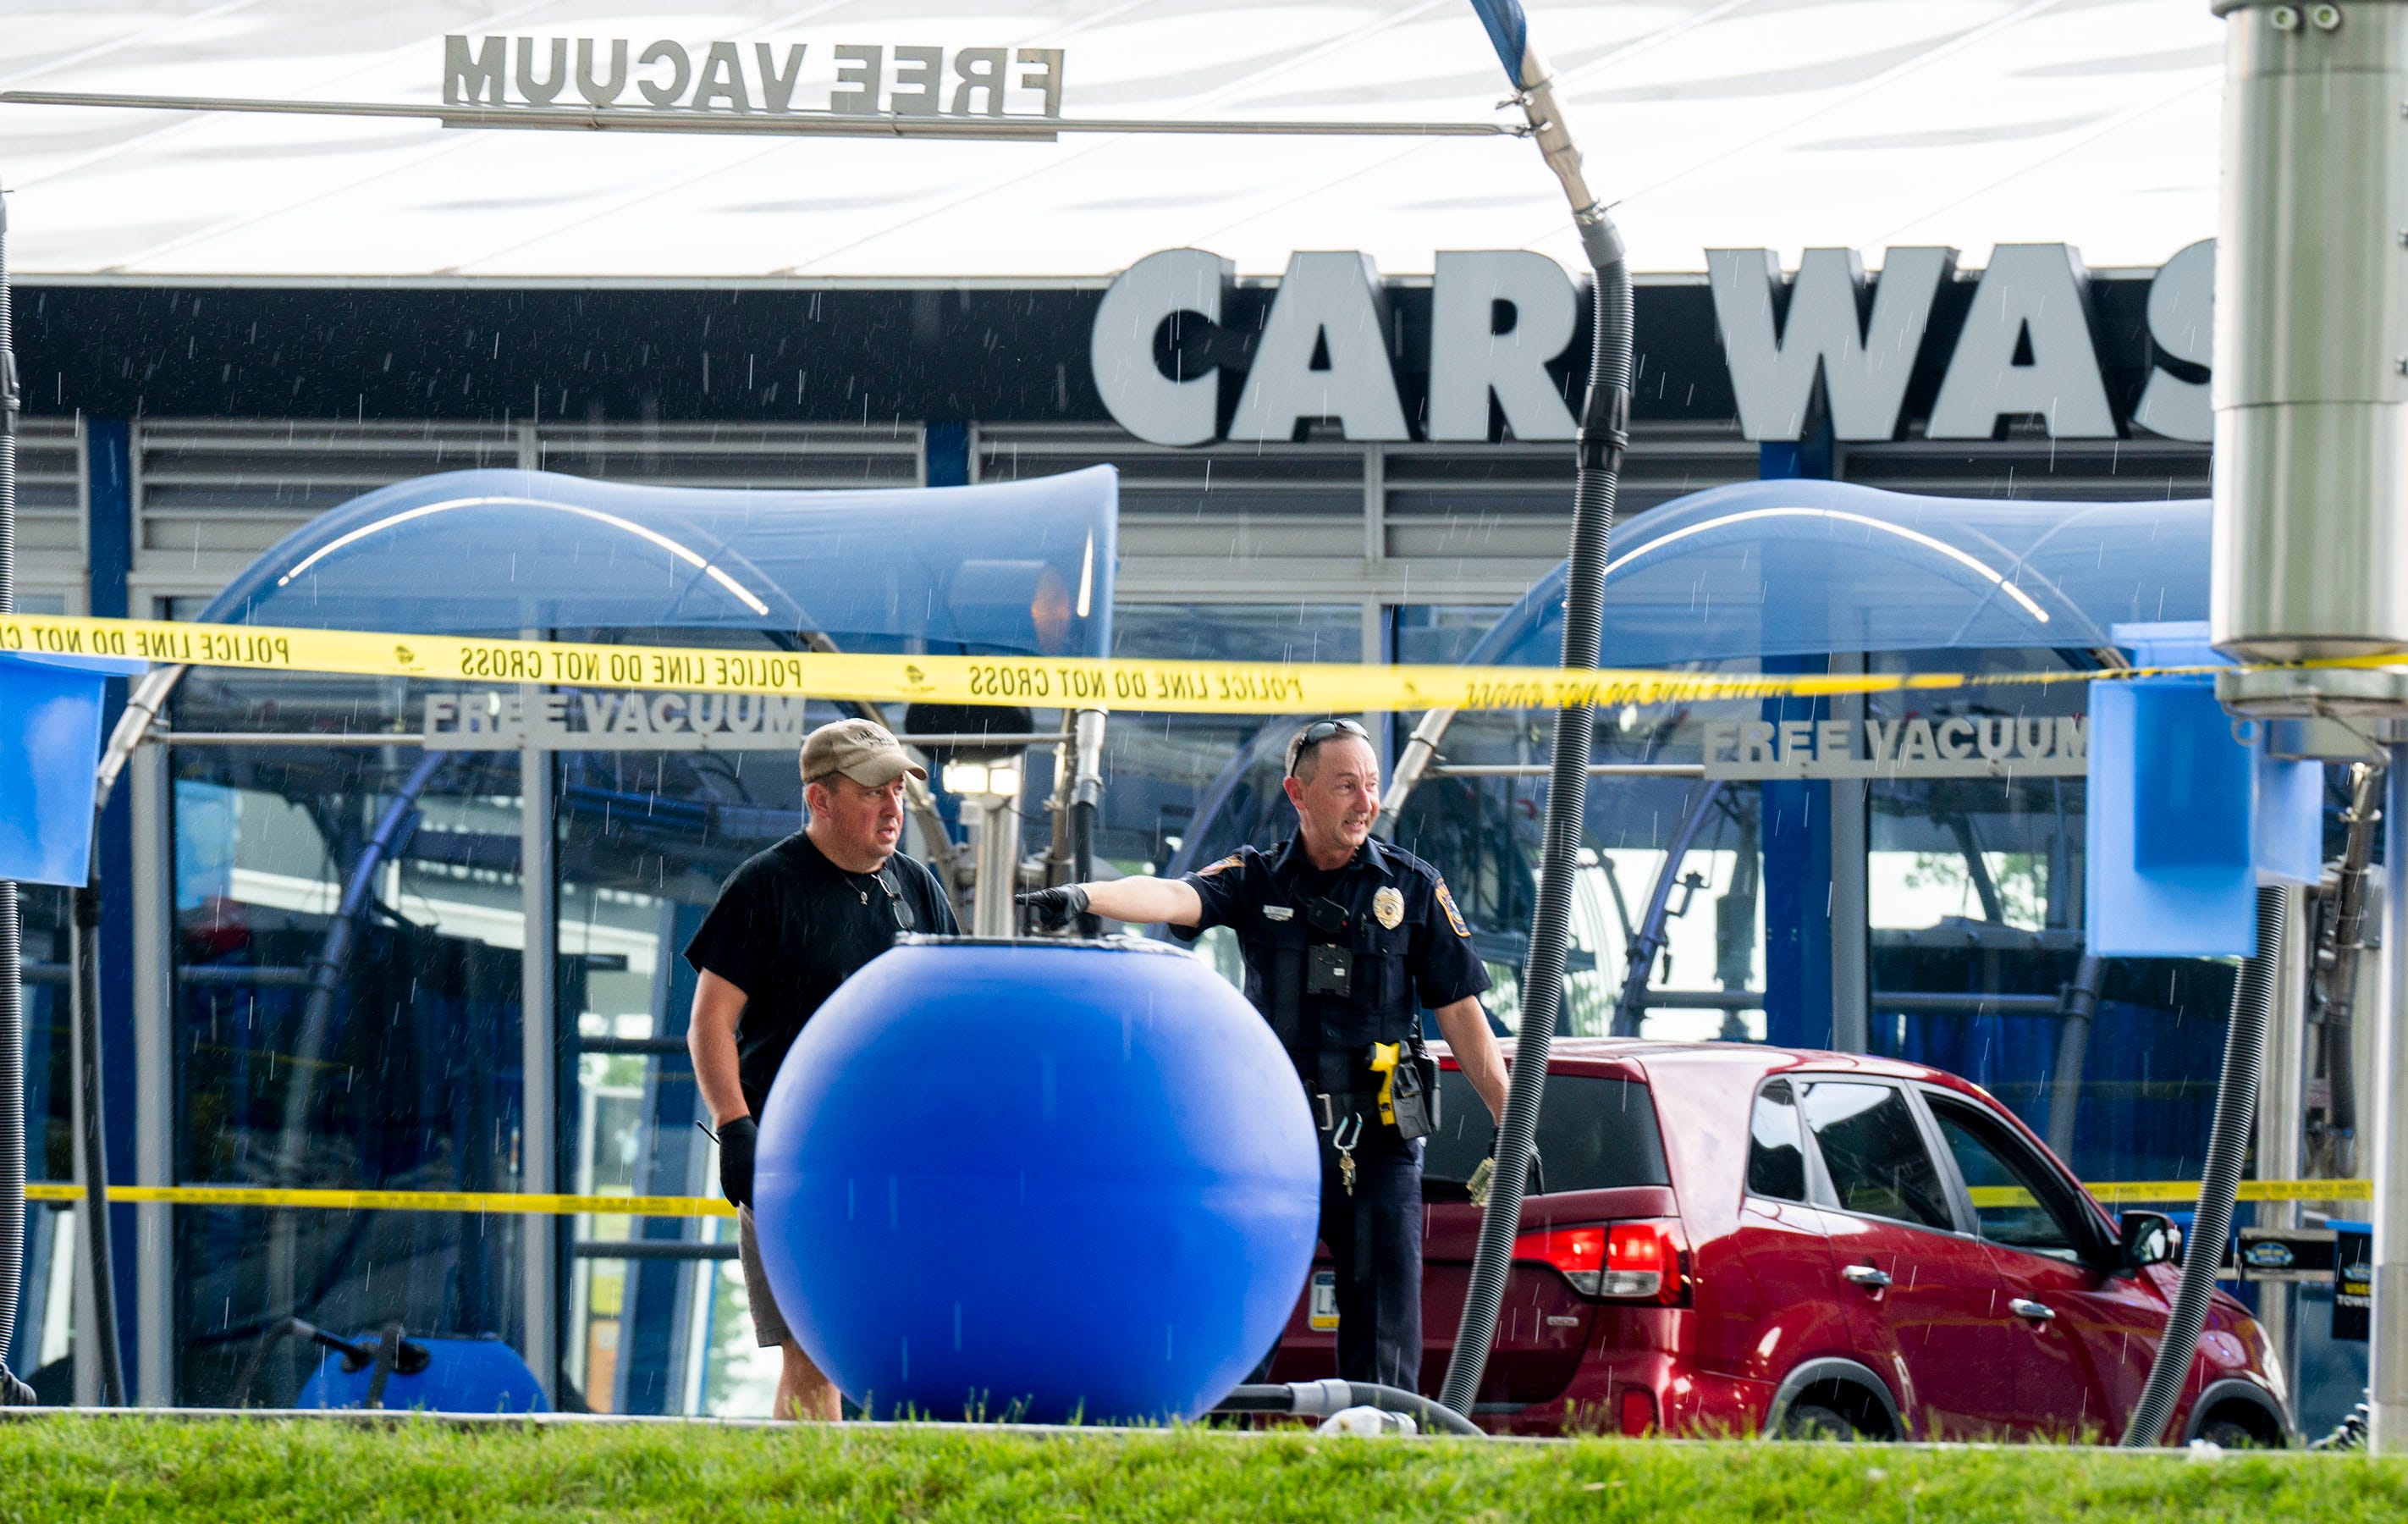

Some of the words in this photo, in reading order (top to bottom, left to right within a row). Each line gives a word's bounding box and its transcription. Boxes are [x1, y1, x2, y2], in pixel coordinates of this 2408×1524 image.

[1090, 246, 1583, 447] CAR
[426, 694, 569, 734] FREE
[581, 693, 804, 734] VACUUM
[1703, 720, 1851, 761] FREE
[1865, 716, 2088, 760] VACUUM
